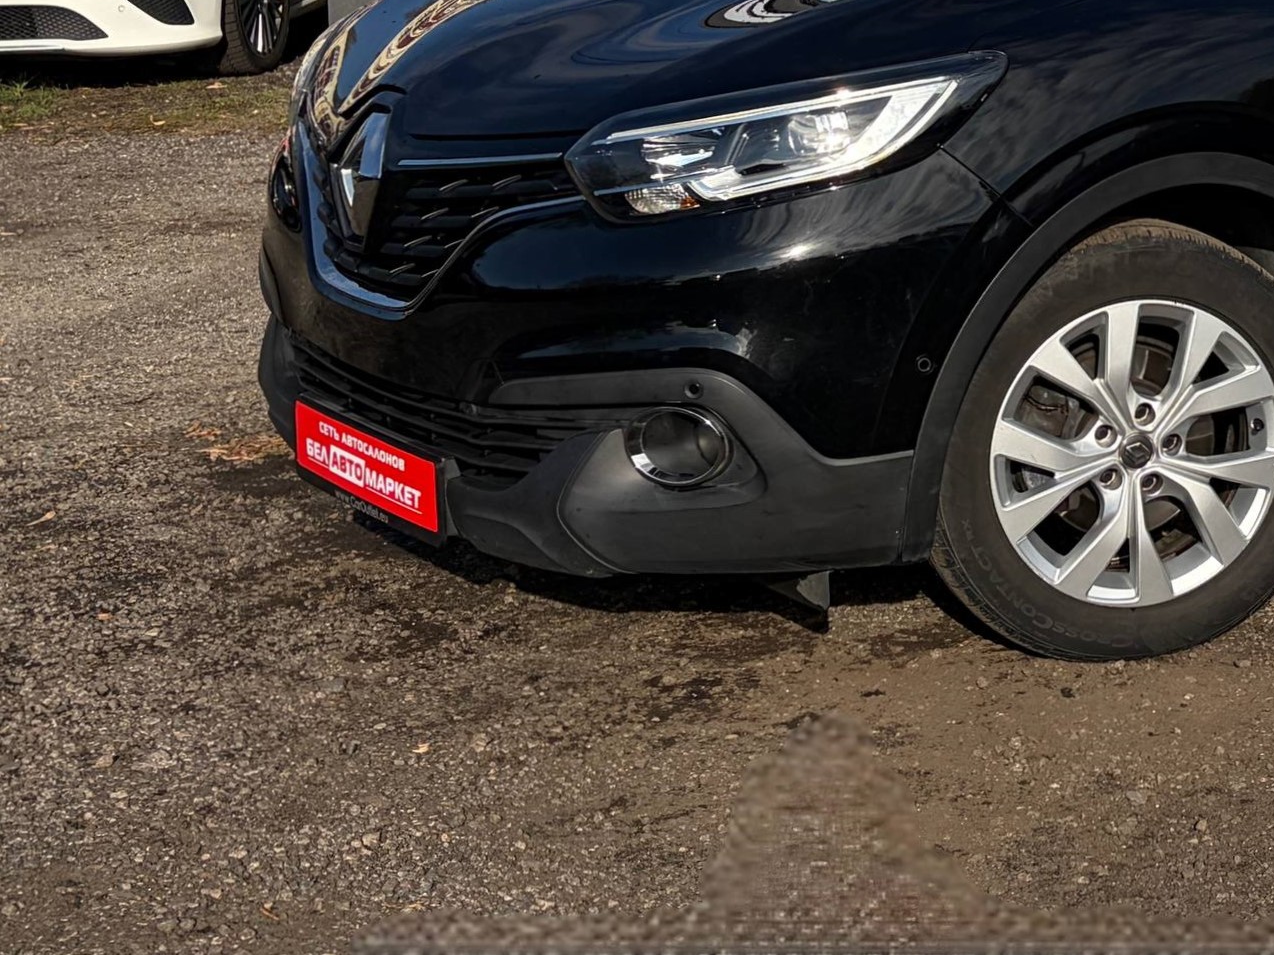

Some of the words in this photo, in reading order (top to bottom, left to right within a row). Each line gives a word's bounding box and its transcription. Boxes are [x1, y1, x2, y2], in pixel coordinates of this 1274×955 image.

[306, 437, 330, 466] БЕЛ
[331, 446, 363, 483] АВТО
[365, 467, 422, 509] МАРКЕТ
[319, 421, 340, 441] СЕТЬ
[341, 432, 405, 472] АВТОСАЛОНОВ
